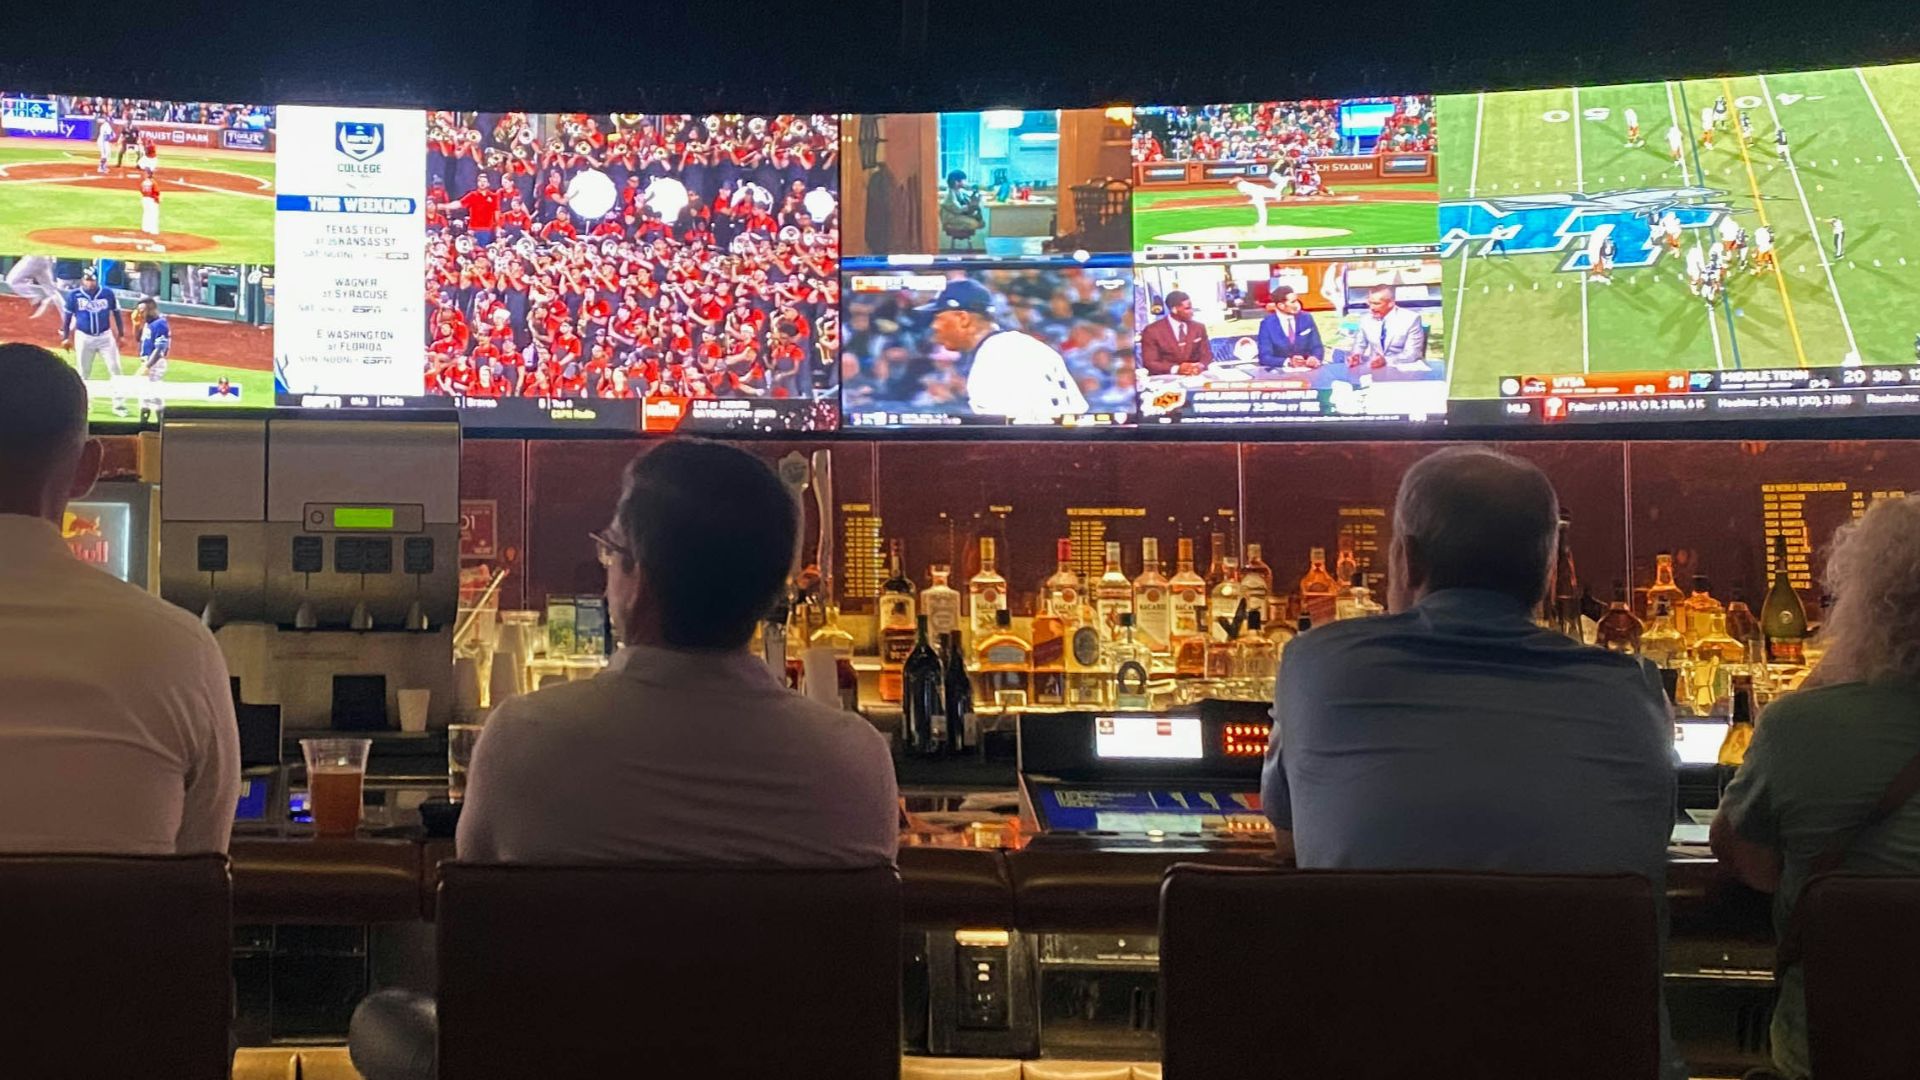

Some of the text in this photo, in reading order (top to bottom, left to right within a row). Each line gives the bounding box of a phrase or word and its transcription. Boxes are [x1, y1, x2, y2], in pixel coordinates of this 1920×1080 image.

[186, 133, 209, 143] PARK
[1331, 162, 1374, 172] STADIUM
[309, 196, 411, 214] THIS WEEKEND
[326, 225, 389, 234] TEXAS TECH
[339, 237, 381, 246] KANSAS
[335, 278, 378, 287] WAGNER
[335, 290, 388, 299] SYRACUSE
[328, 331, 394, 339] WASHINGTON
[340, 342, 382, 351] FLORIDA
[1720, 371, 1772, 383] MIDDLE
[1843, 369, 1866, 384] 20
